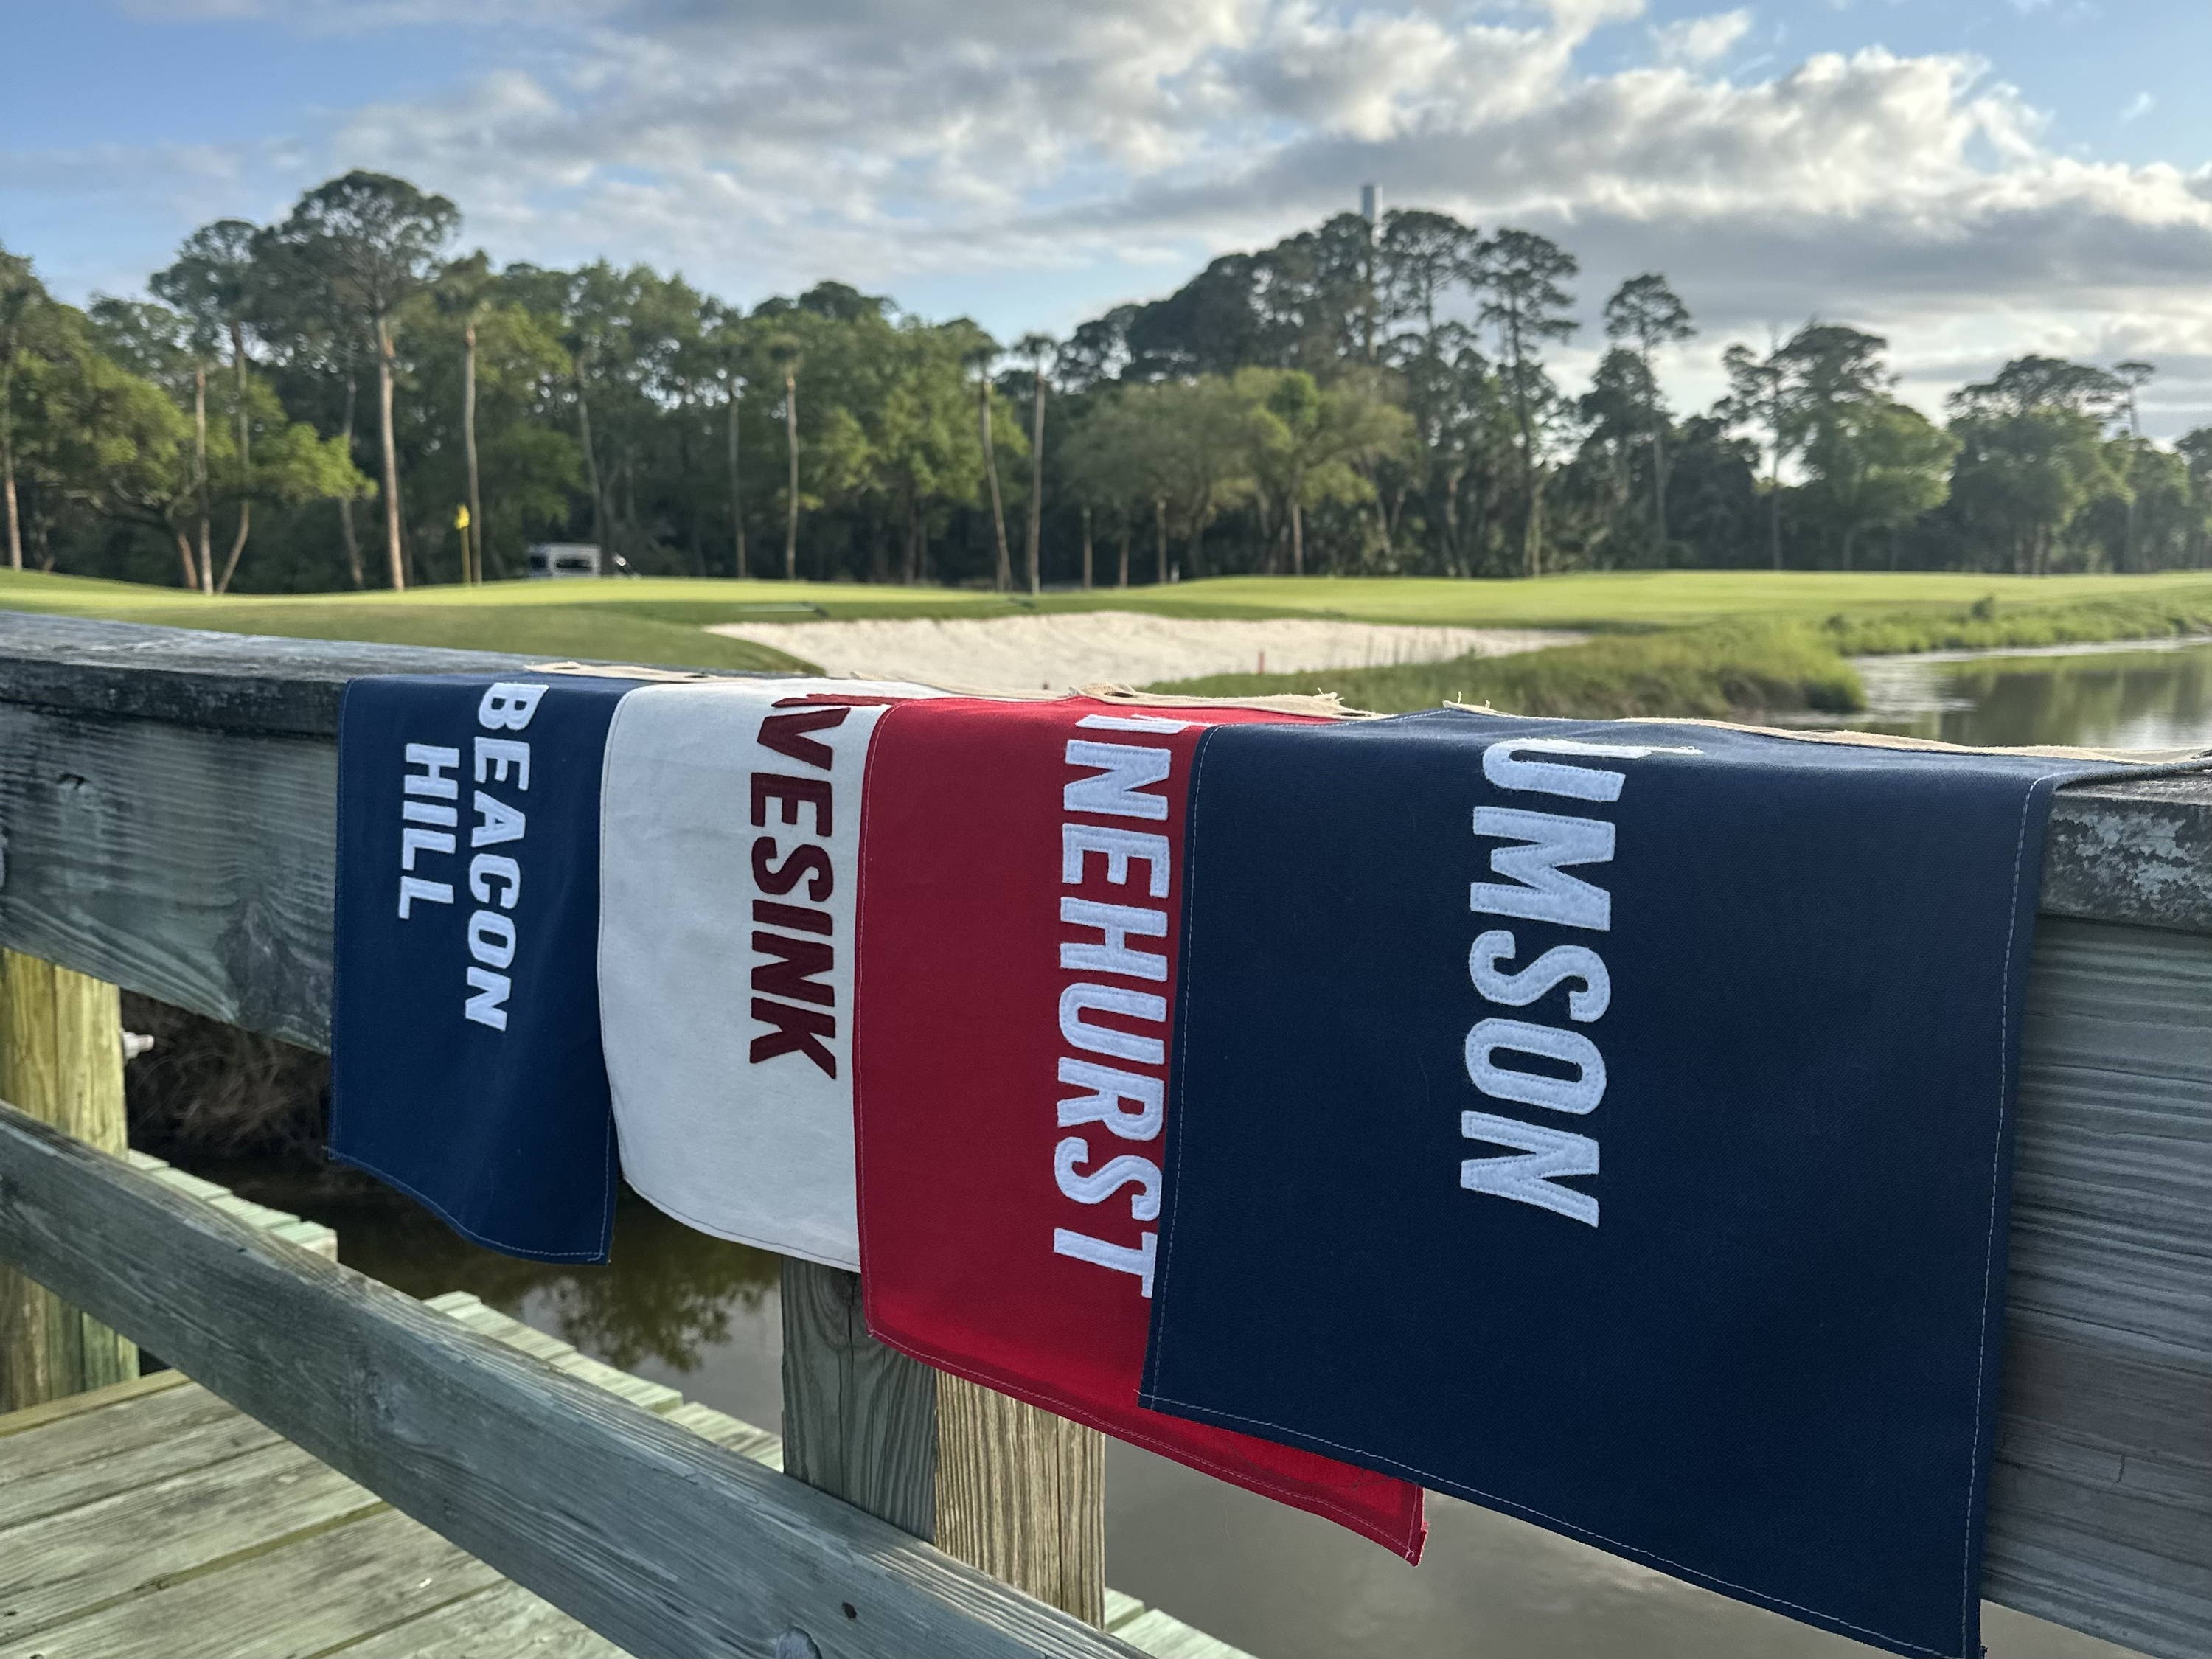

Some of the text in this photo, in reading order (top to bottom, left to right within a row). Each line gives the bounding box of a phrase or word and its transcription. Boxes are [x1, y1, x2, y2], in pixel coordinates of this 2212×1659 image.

[398, 743, 460, 919] HILL
[465, 682, 549, 1031] BEACON
[750, 694, 892, 1079] VESINK
[1053, 714, 1206, 1298] INEHURST
[1460, 739, 1696, 1227] UMSON
